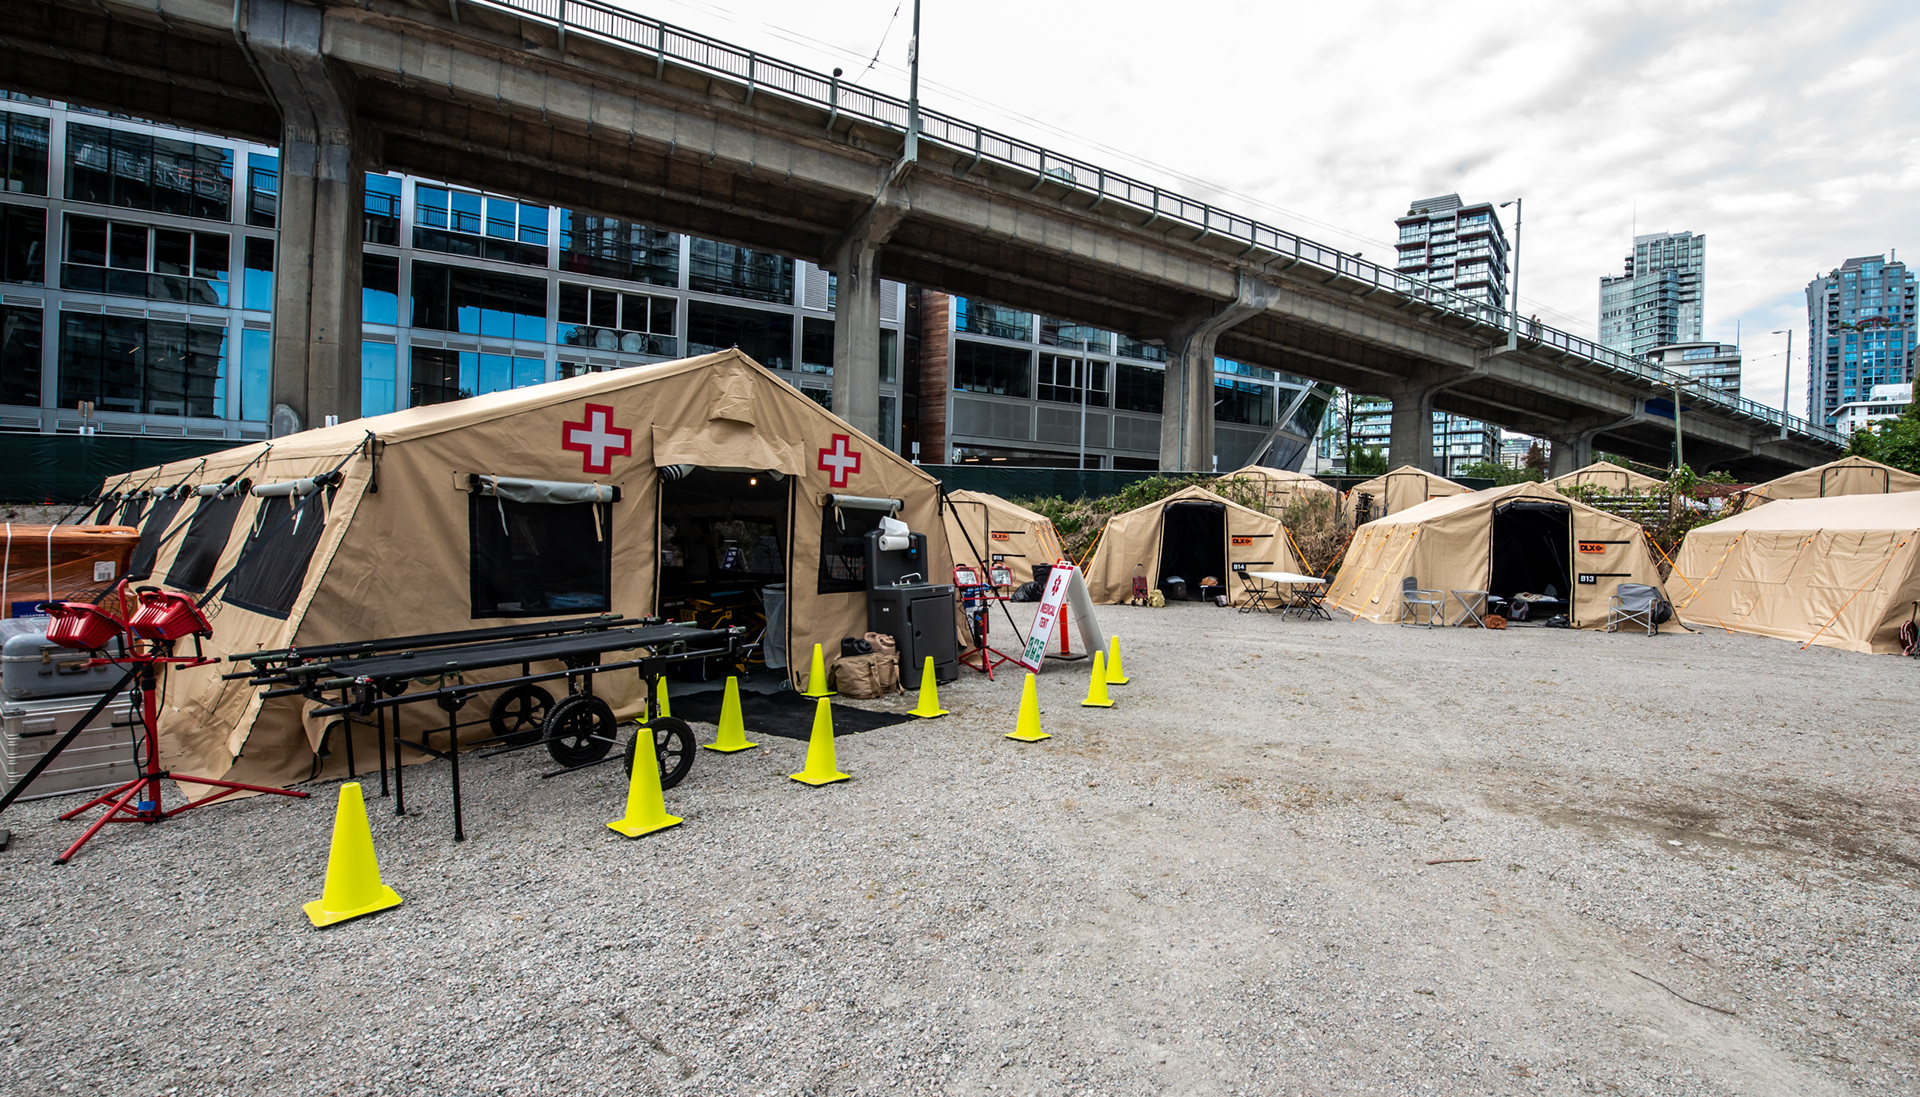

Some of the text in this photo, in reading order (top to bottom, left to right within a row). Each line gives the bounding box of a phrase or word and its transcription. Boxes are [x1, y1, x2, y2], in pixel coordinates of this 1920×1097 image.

[1580, 544, 1596, 552] DLX
[1580, 575, 1595, 583] B13
[1040, 602, 1057, 617] MEDICAL
[1039, 616, 1049, 629] TENT
